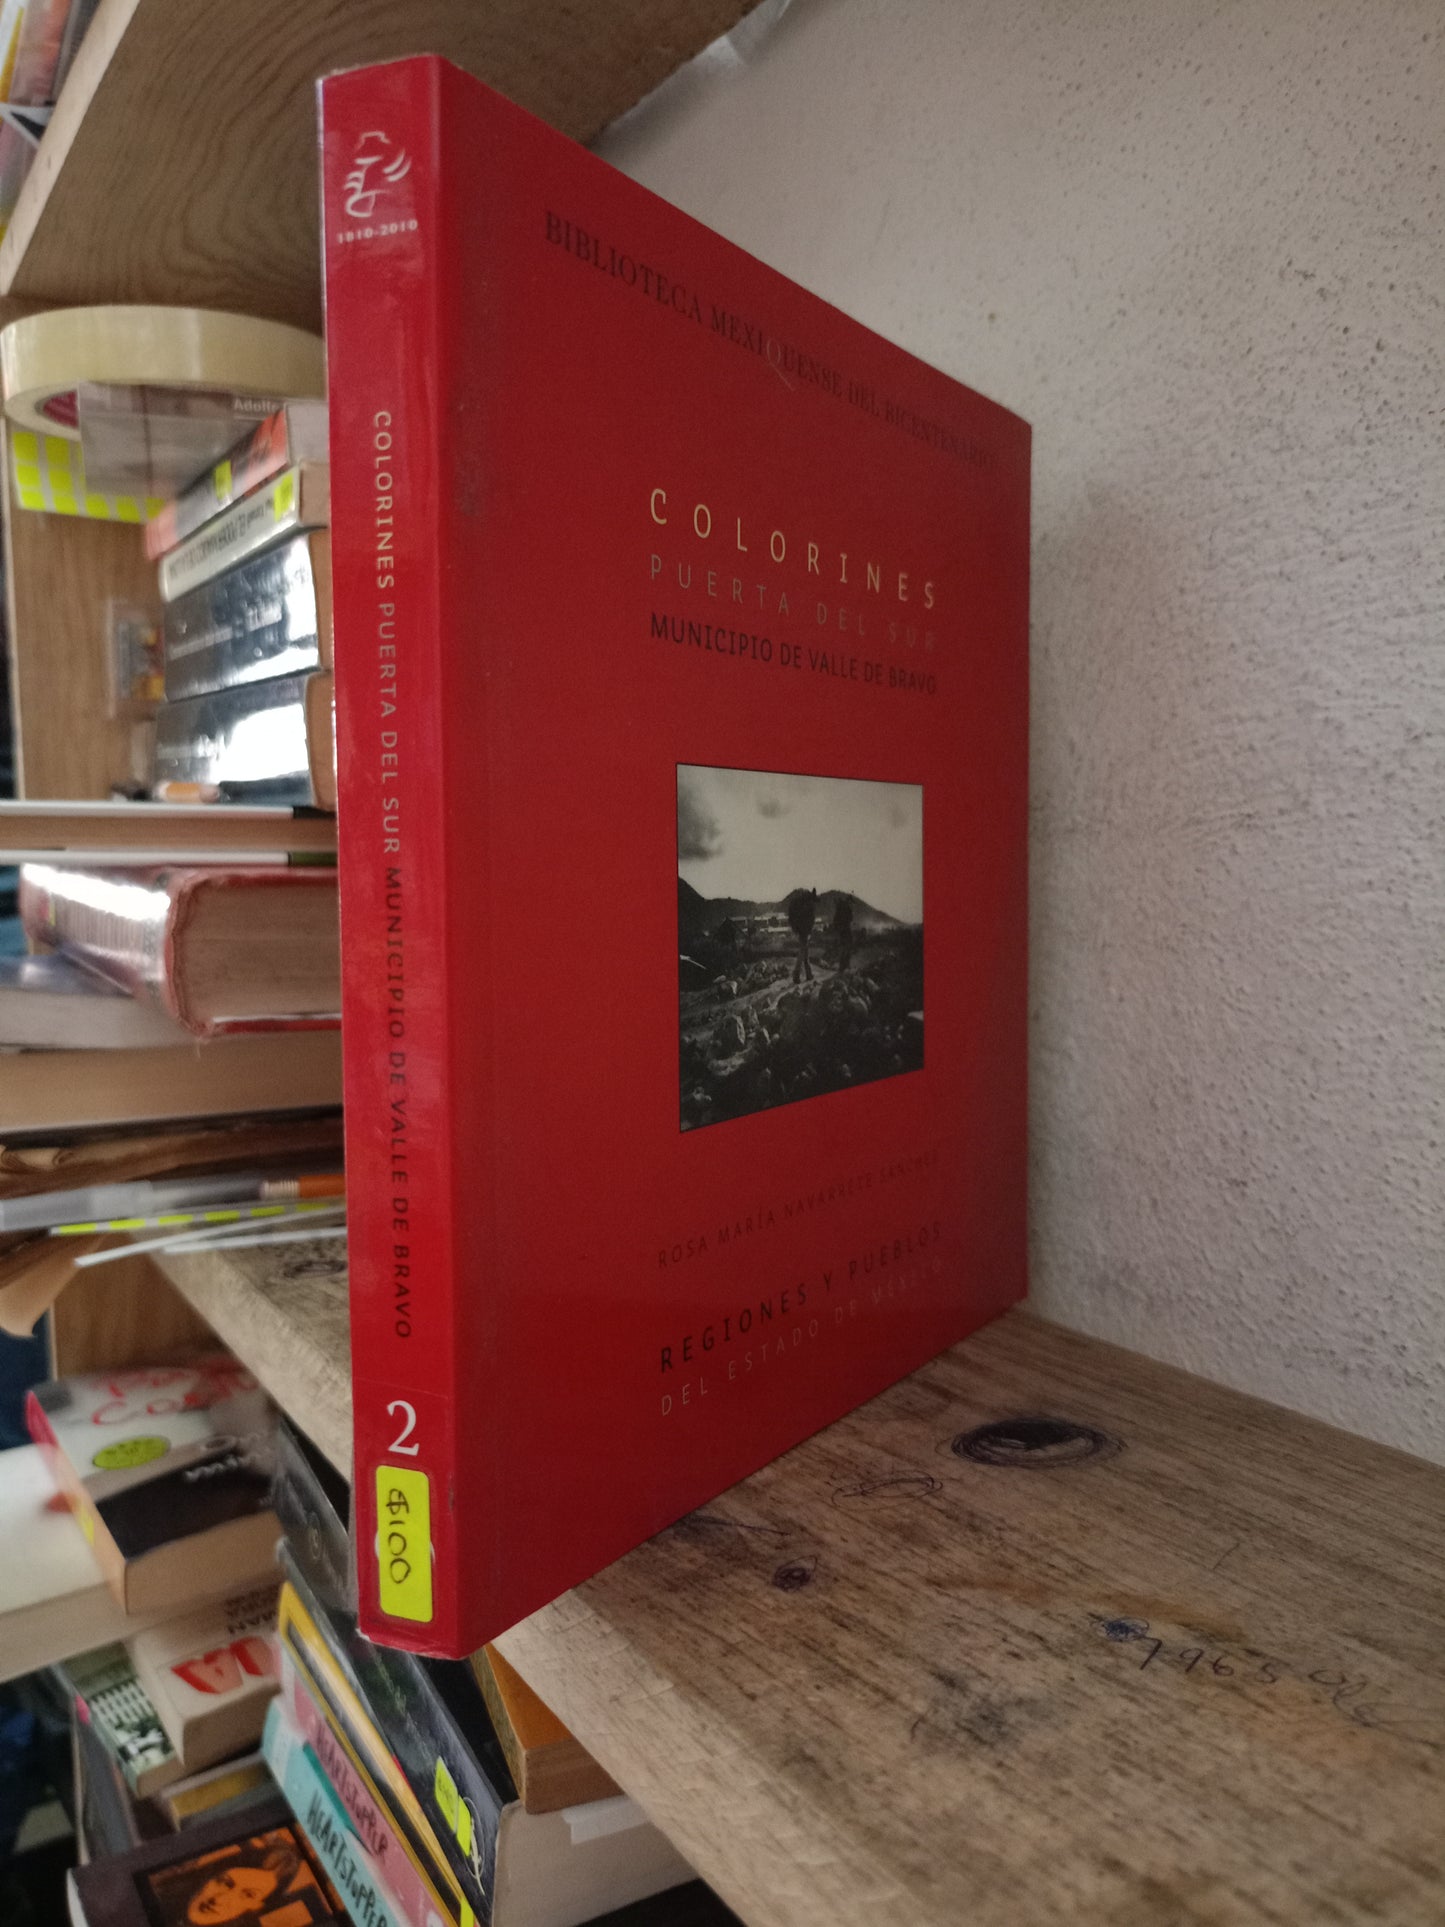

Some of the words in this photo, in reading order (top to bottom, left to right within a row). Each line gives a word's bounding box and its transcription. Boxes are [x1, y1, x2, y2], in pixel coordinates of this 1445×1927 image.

[336, 219, 418, 244] 1810-2010
[545, 209, 703, 325] BIBLIOTECA
[710, 303, 843, 399] MEXIQUENSE
[373, 410, 395, 590] COLORINES
[650, 487, 936, 610] COLORINES
[650, 554, 790, 617] PUERTA
[815, 601, 866, 637] DEL
[888, 620, 937, 651] SUR
[378, 602, 397, 718] PUERTA
[650, 611, 773, 663] MUNICIPIO
[779, 641, 803, 670] DE
[807, 647, 859, 681] VALLE
[862, 660, 884, 686] DE
[888, 665, 938, 696] BRAVO
[380, 730, 399, 784] DEL
[382, 797, 400, 855] SUR
[384, 867, 406, 1039] MUNICIPIO
[389, 1051, 407, 1085] DE
[390, 1099, 409, 1184] VALLE
[392, 1197, 410, 1233] DE
[658, 1236, 709, 1269] ROSA
[393, 1243, 412, 1339] BRAVO
[660, 1282, 807, 1374] REGIONES
[822, 1270, 833, 1293] Y
[848, 1220, 942, 1281] PUEBLOS
[660, 1376, 709, 1417] DEL
[727, 1318, 819, 1383] ESTADO
[834, 1299, 857, 1325] DE
[386, 1399, 420, 1457] 2
[385, 1488, 412, 1584] $100
